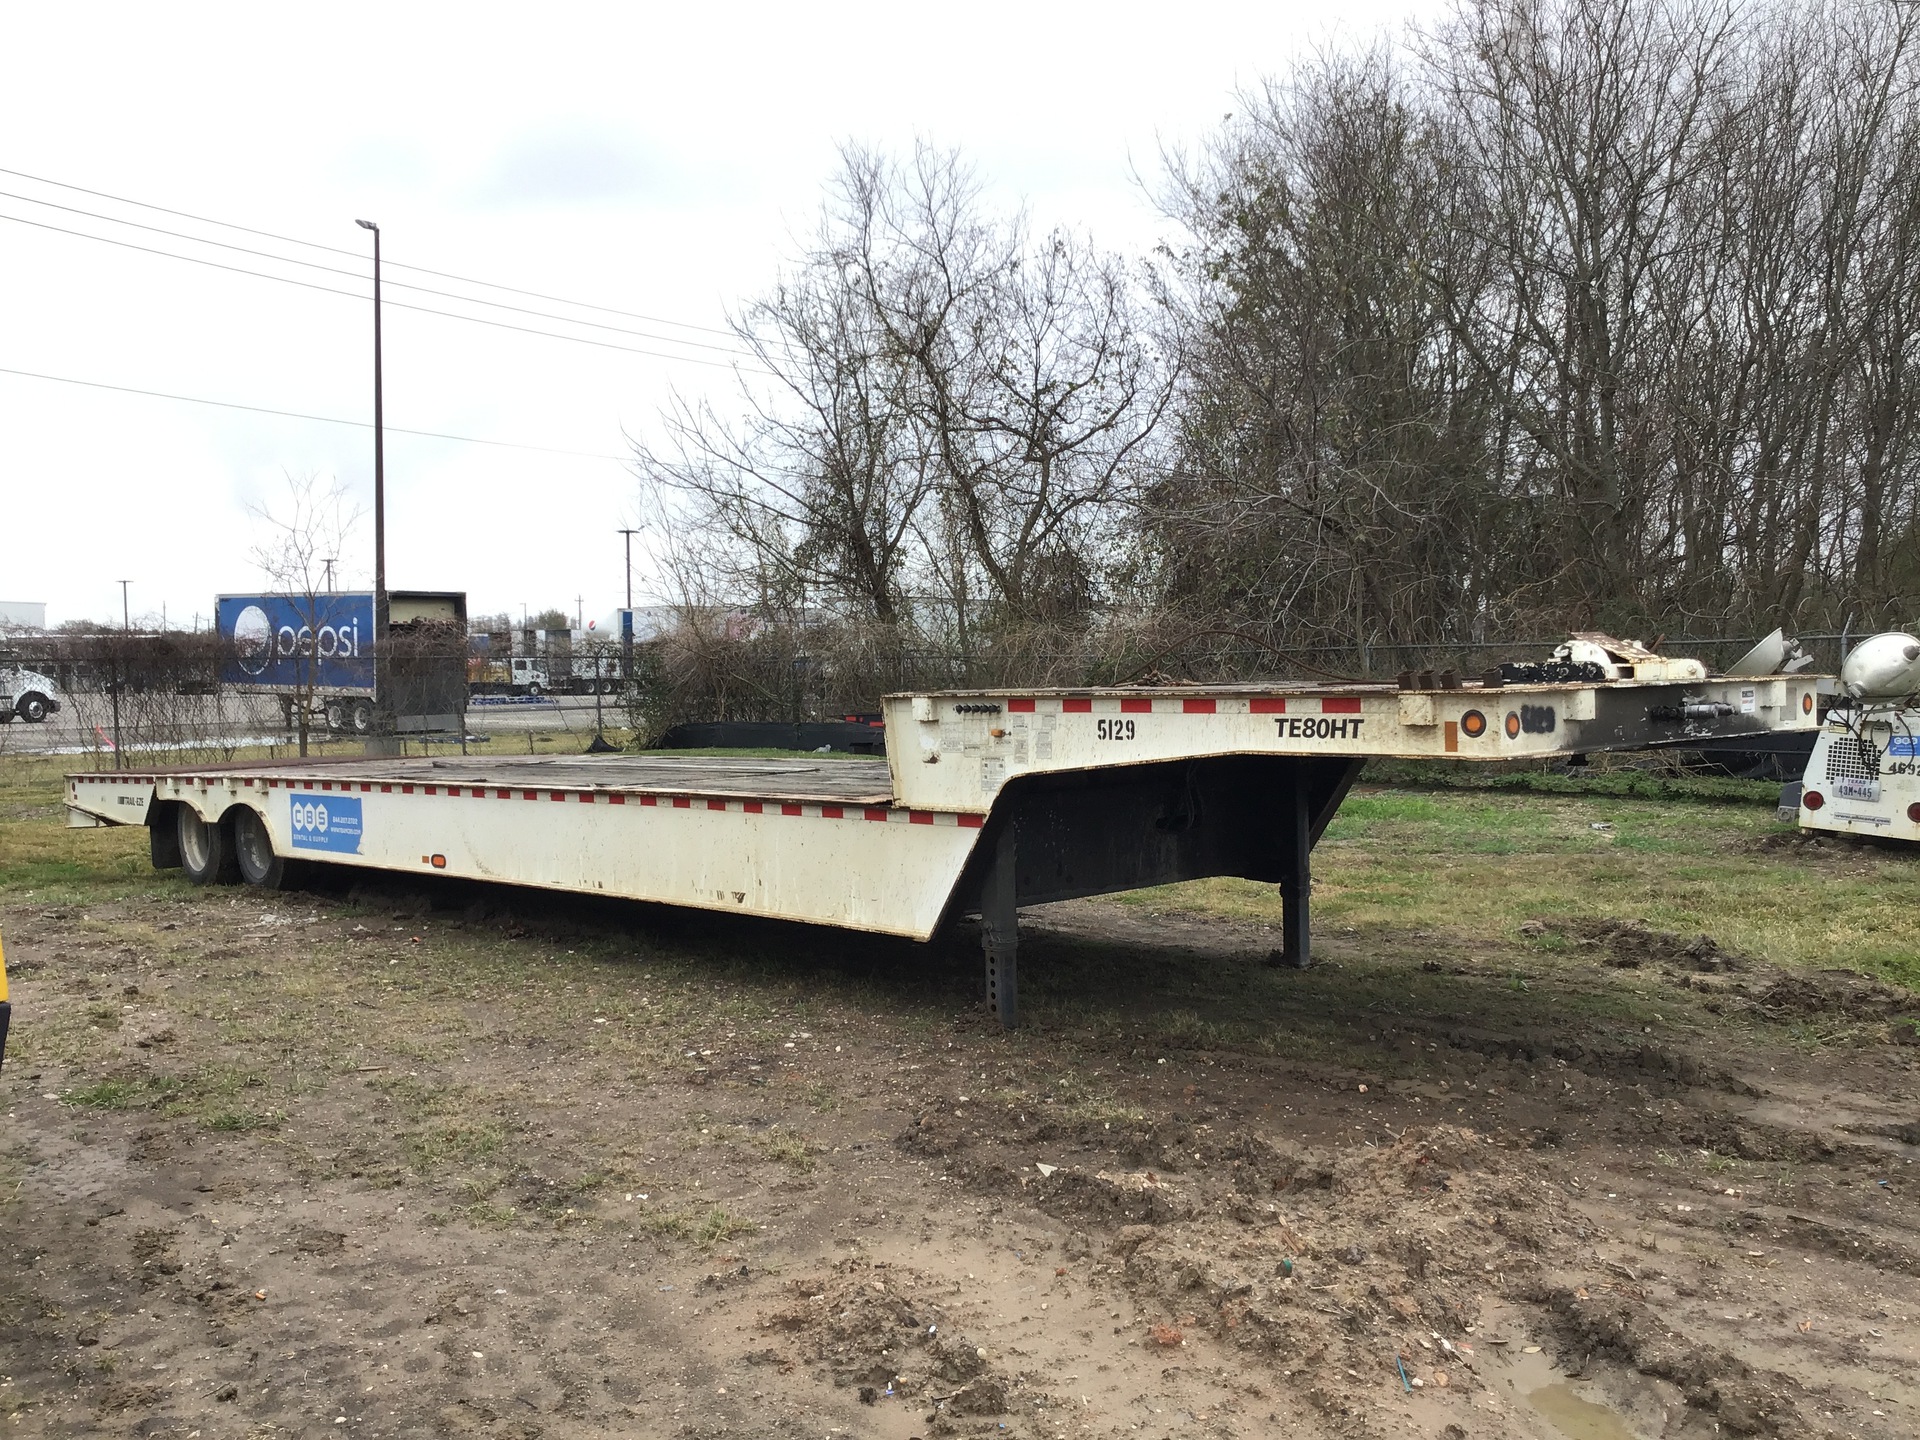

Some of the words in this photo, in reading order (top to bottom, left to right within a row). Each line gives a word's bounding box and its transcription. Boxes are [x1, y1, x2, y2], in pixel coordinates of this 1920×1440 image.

[277, 617, 358, 665] pepsi
[1097, 719, 1135, 741] 5129
[1275, 718, 1365, 739] TE80HT
[294, 806, 327, 829] CBS
